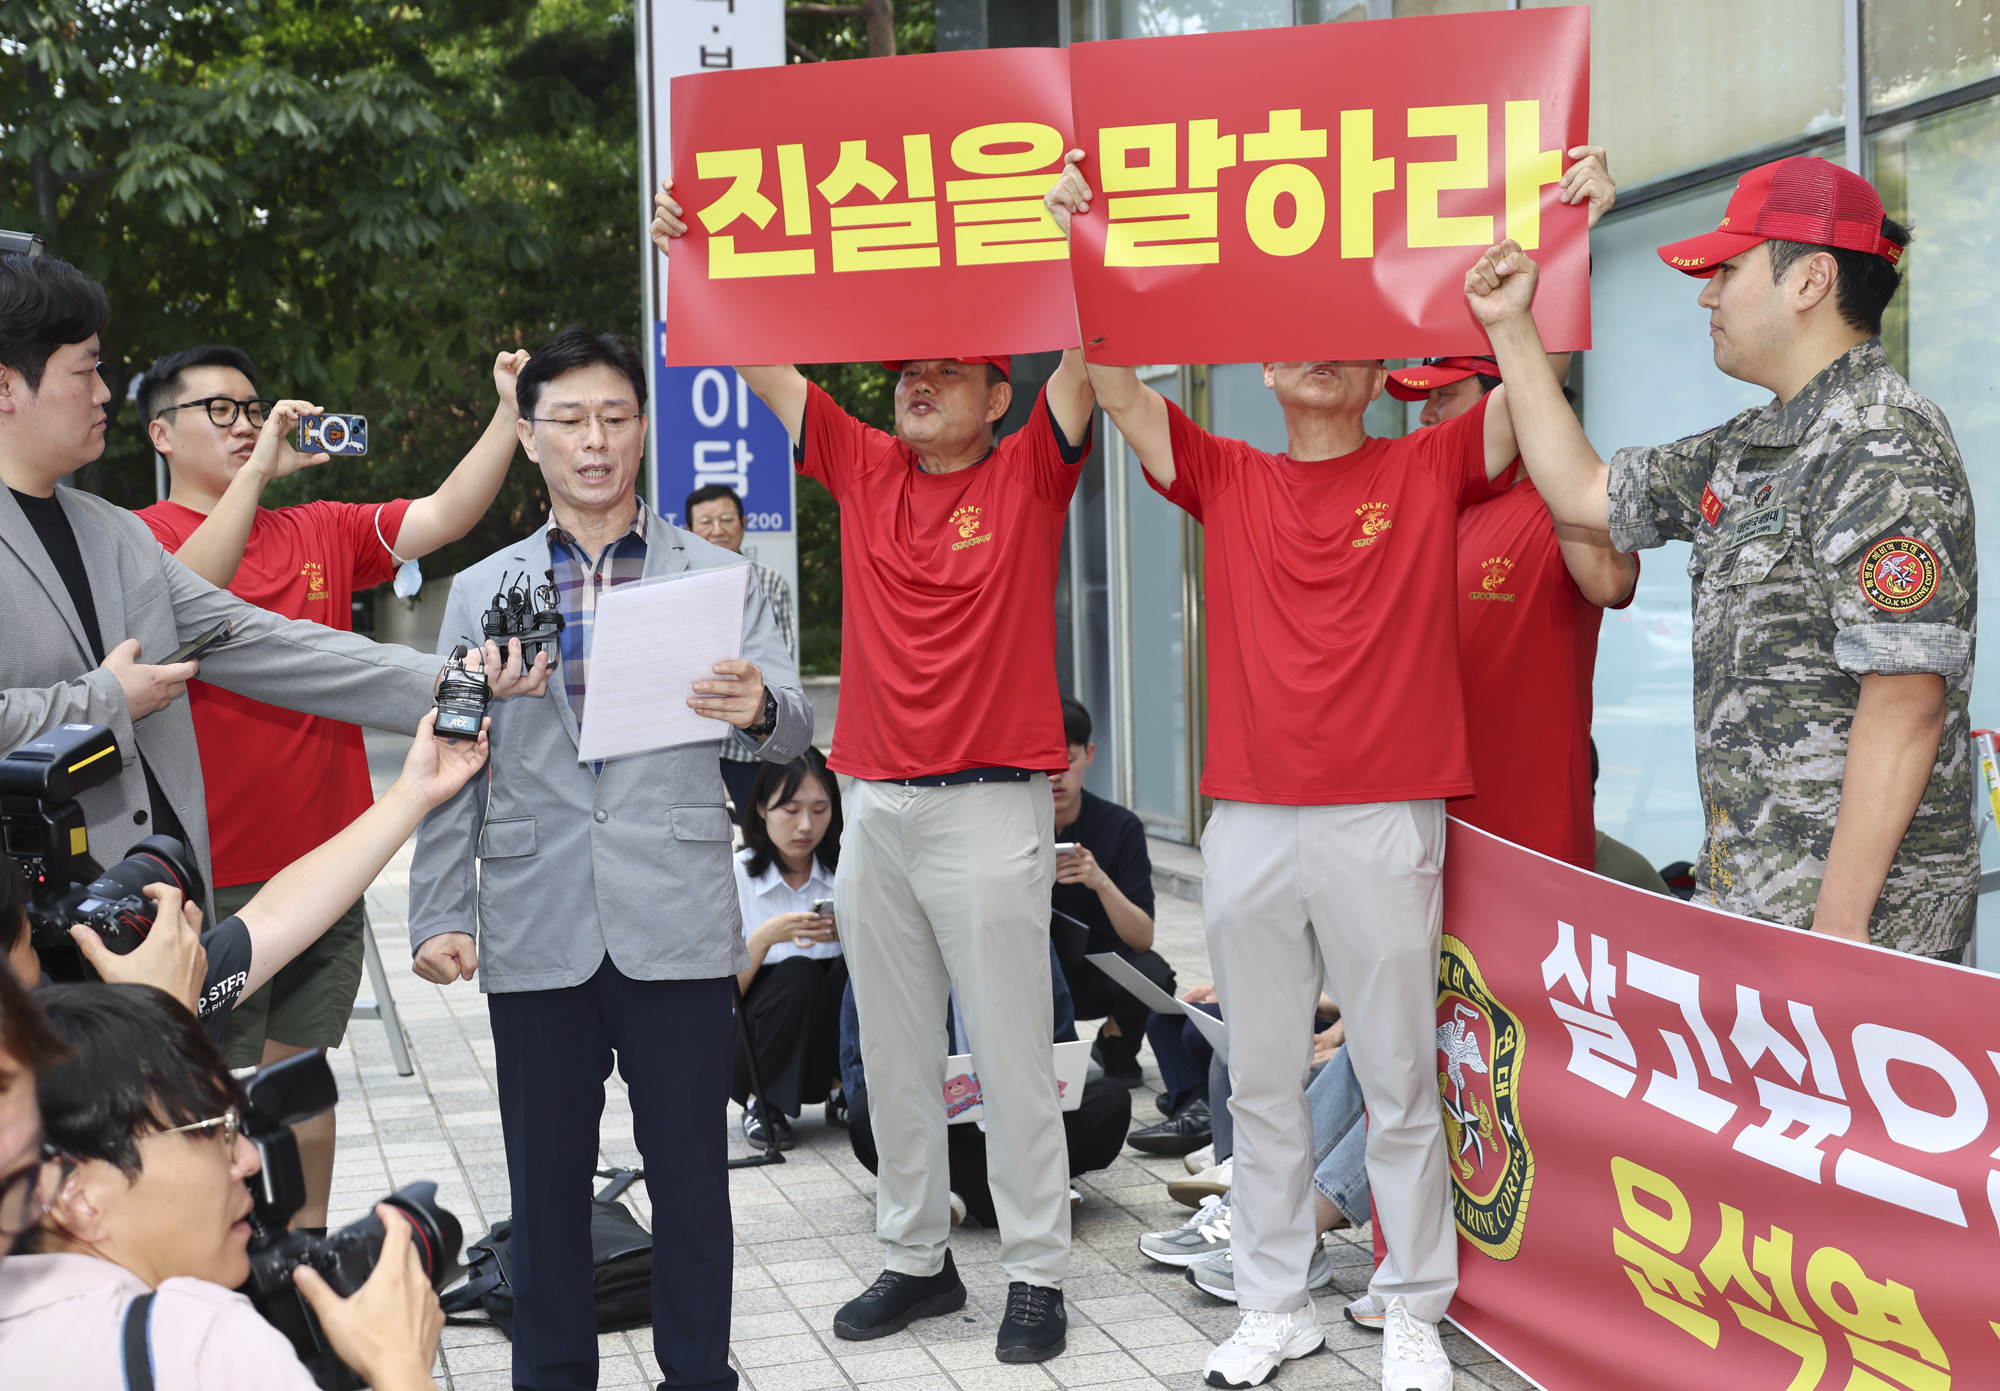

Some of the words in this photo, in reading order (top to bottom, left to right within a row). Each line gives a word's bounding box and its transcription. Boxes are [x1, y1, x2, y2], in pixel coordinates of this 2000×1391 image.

[695, 121, 1071, 280] 진실을
[1098, 99, 1563, 267] 말하라
[1671, 256, 1705, 266] ROKMC
[1872, 542, 1896, 560] 예비역
[1900, 542, 1919, 555] 연대
[1900, 585, 1930, 606] MARINE
[1923, 560, 1933, 586] CORPS
[1495, 1024, 1515, 1098] 연대
[1541, 920, 2000, 1248] 살고싶으
[1496, 1143, 1524, 1229] CORPS
[1610, 1155, 1952, 1391] 윤석열
